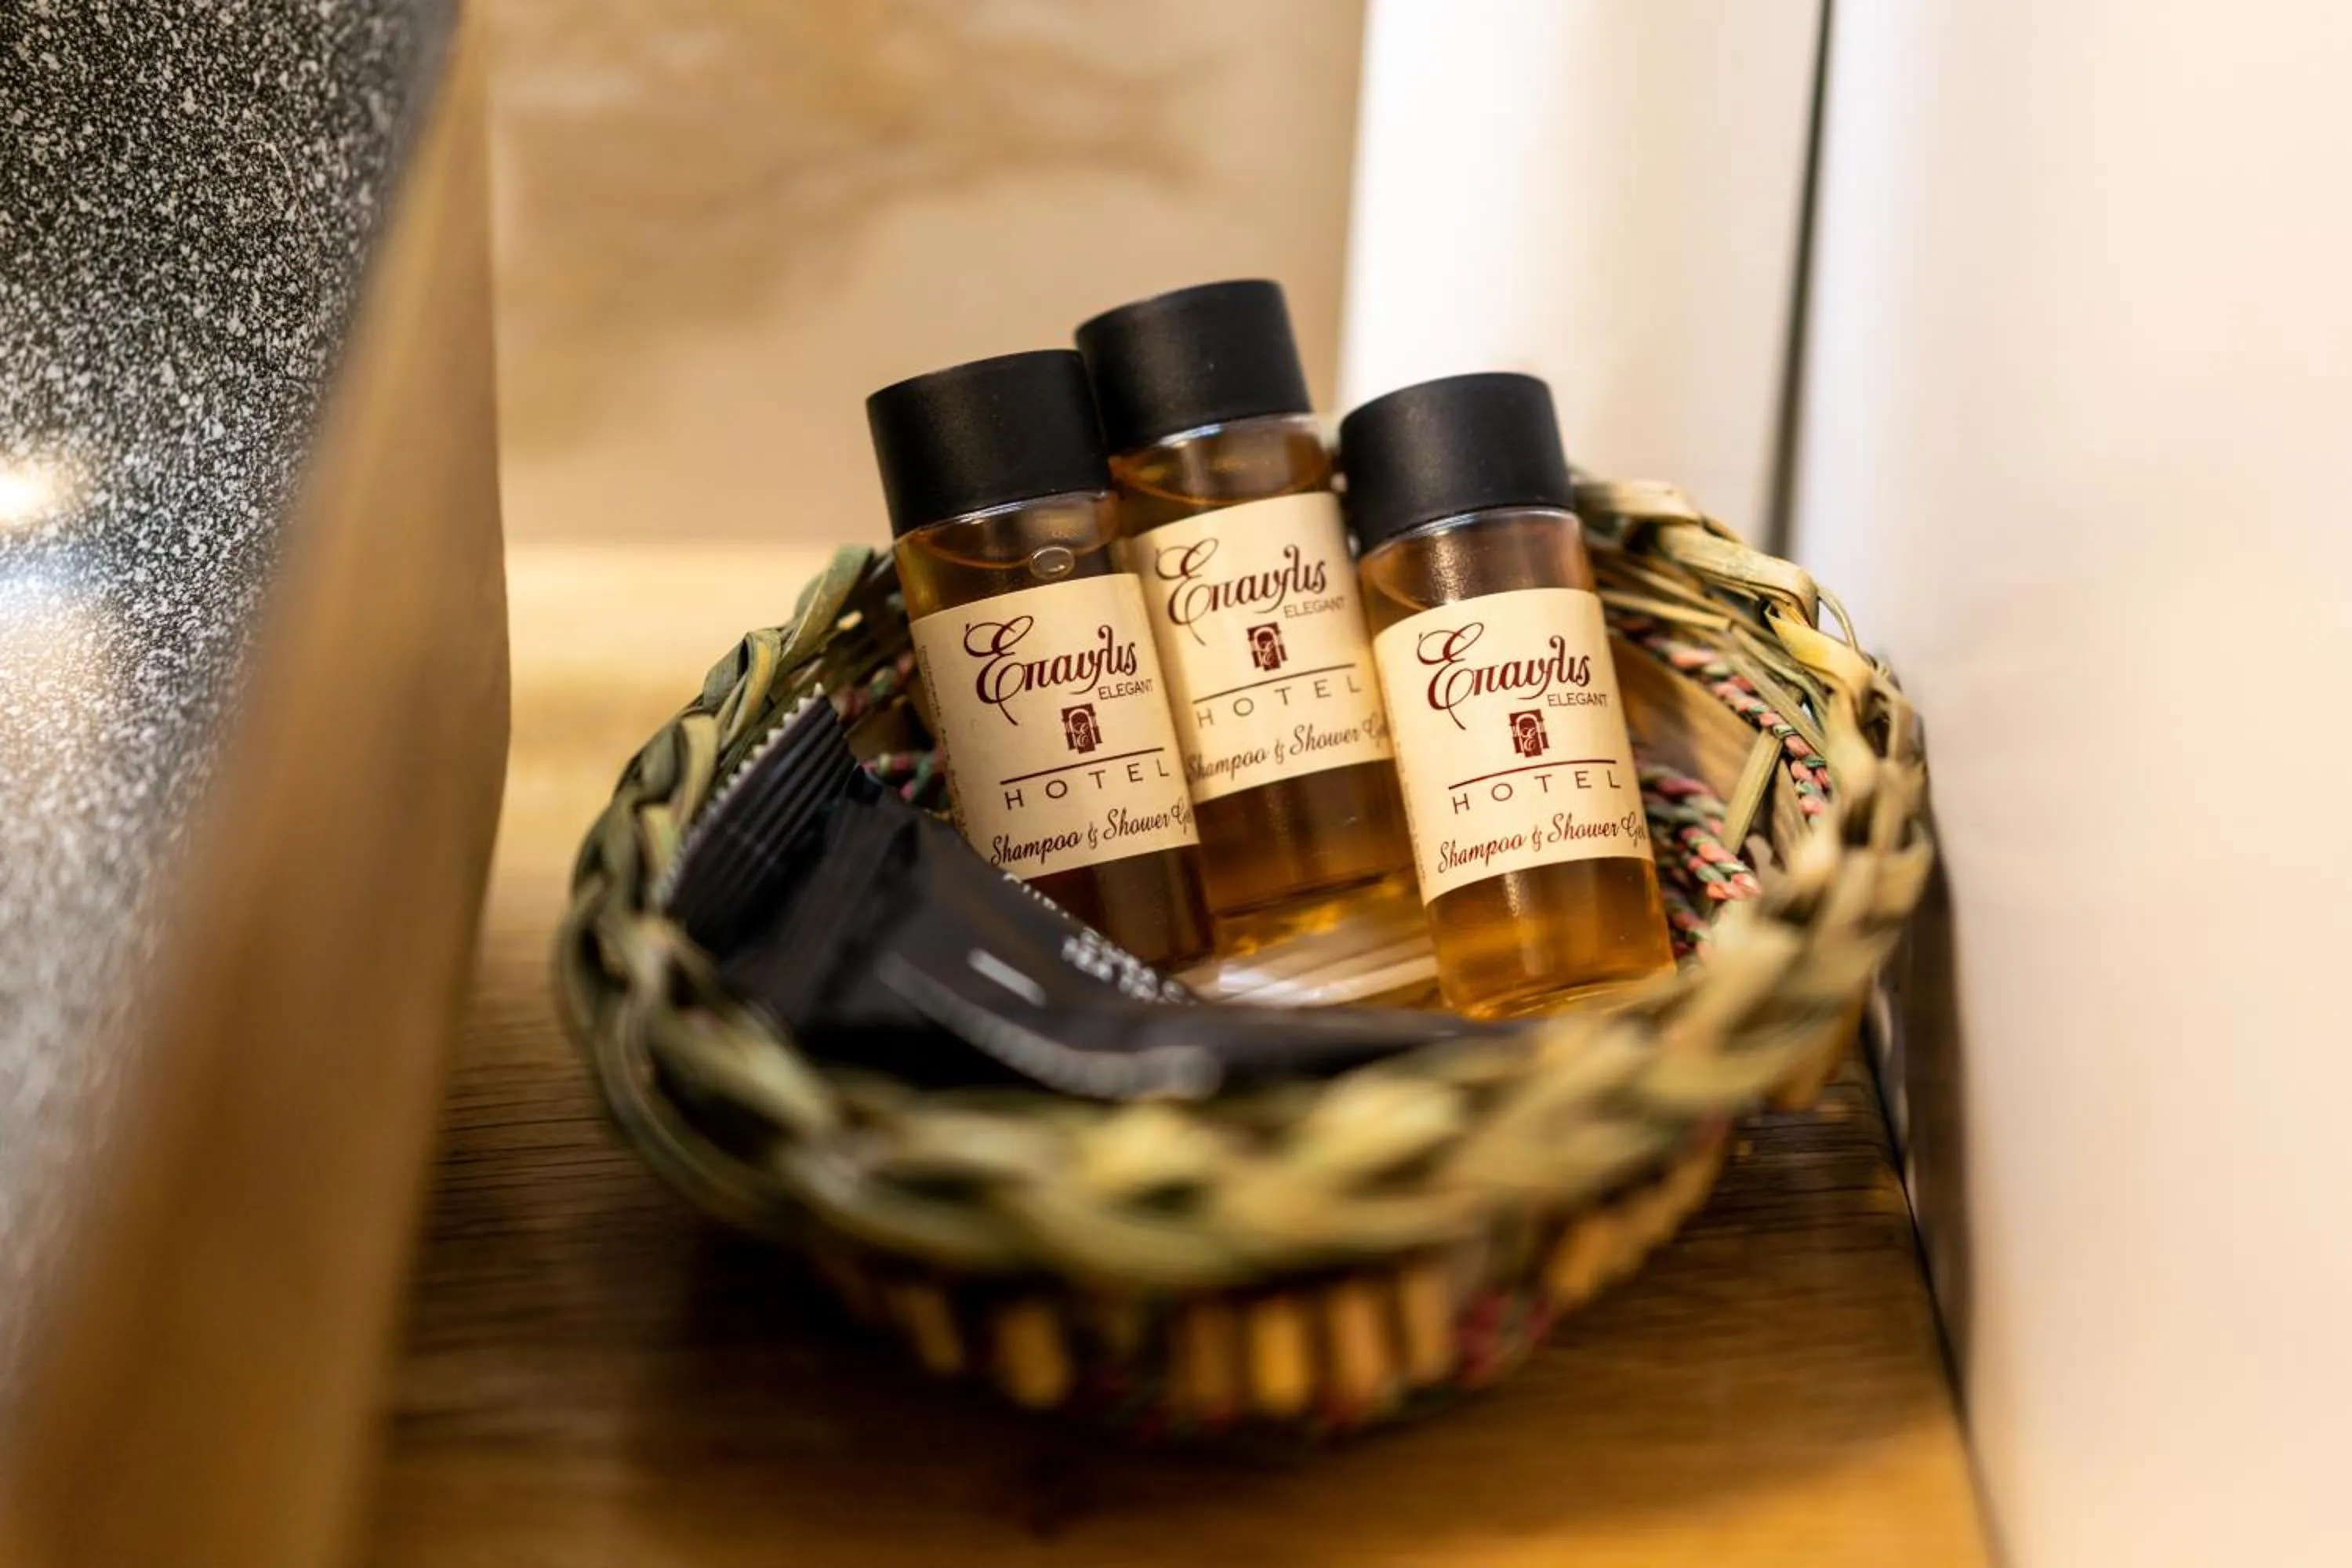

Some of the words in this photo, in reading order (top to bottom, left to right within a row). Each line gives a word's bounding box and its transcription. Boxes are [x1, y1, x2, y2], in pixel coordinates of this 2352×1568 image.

[1284, 596, 1346, 619] ELEGANT
[1098, 679, 1154, 700] ELEGANT
[1196, 676, 1363, 728] HOTEL
[1547, 691, 1608, 707] ELEGANT
[1187, 747, 1268, 782] Shampoo
[1290, 724, 1361, 757] Shower
[1005, 758, 1171, 810] HOTEL
[1452, 769, 1621, 815] HOTEL
[990, 829, 1083, 866] Shampoo
[1103, 808, 1169, 840] Shower
[1438, 835, 1527, 874] Shampoo
[1547, 811, 1620, 844] Shower
